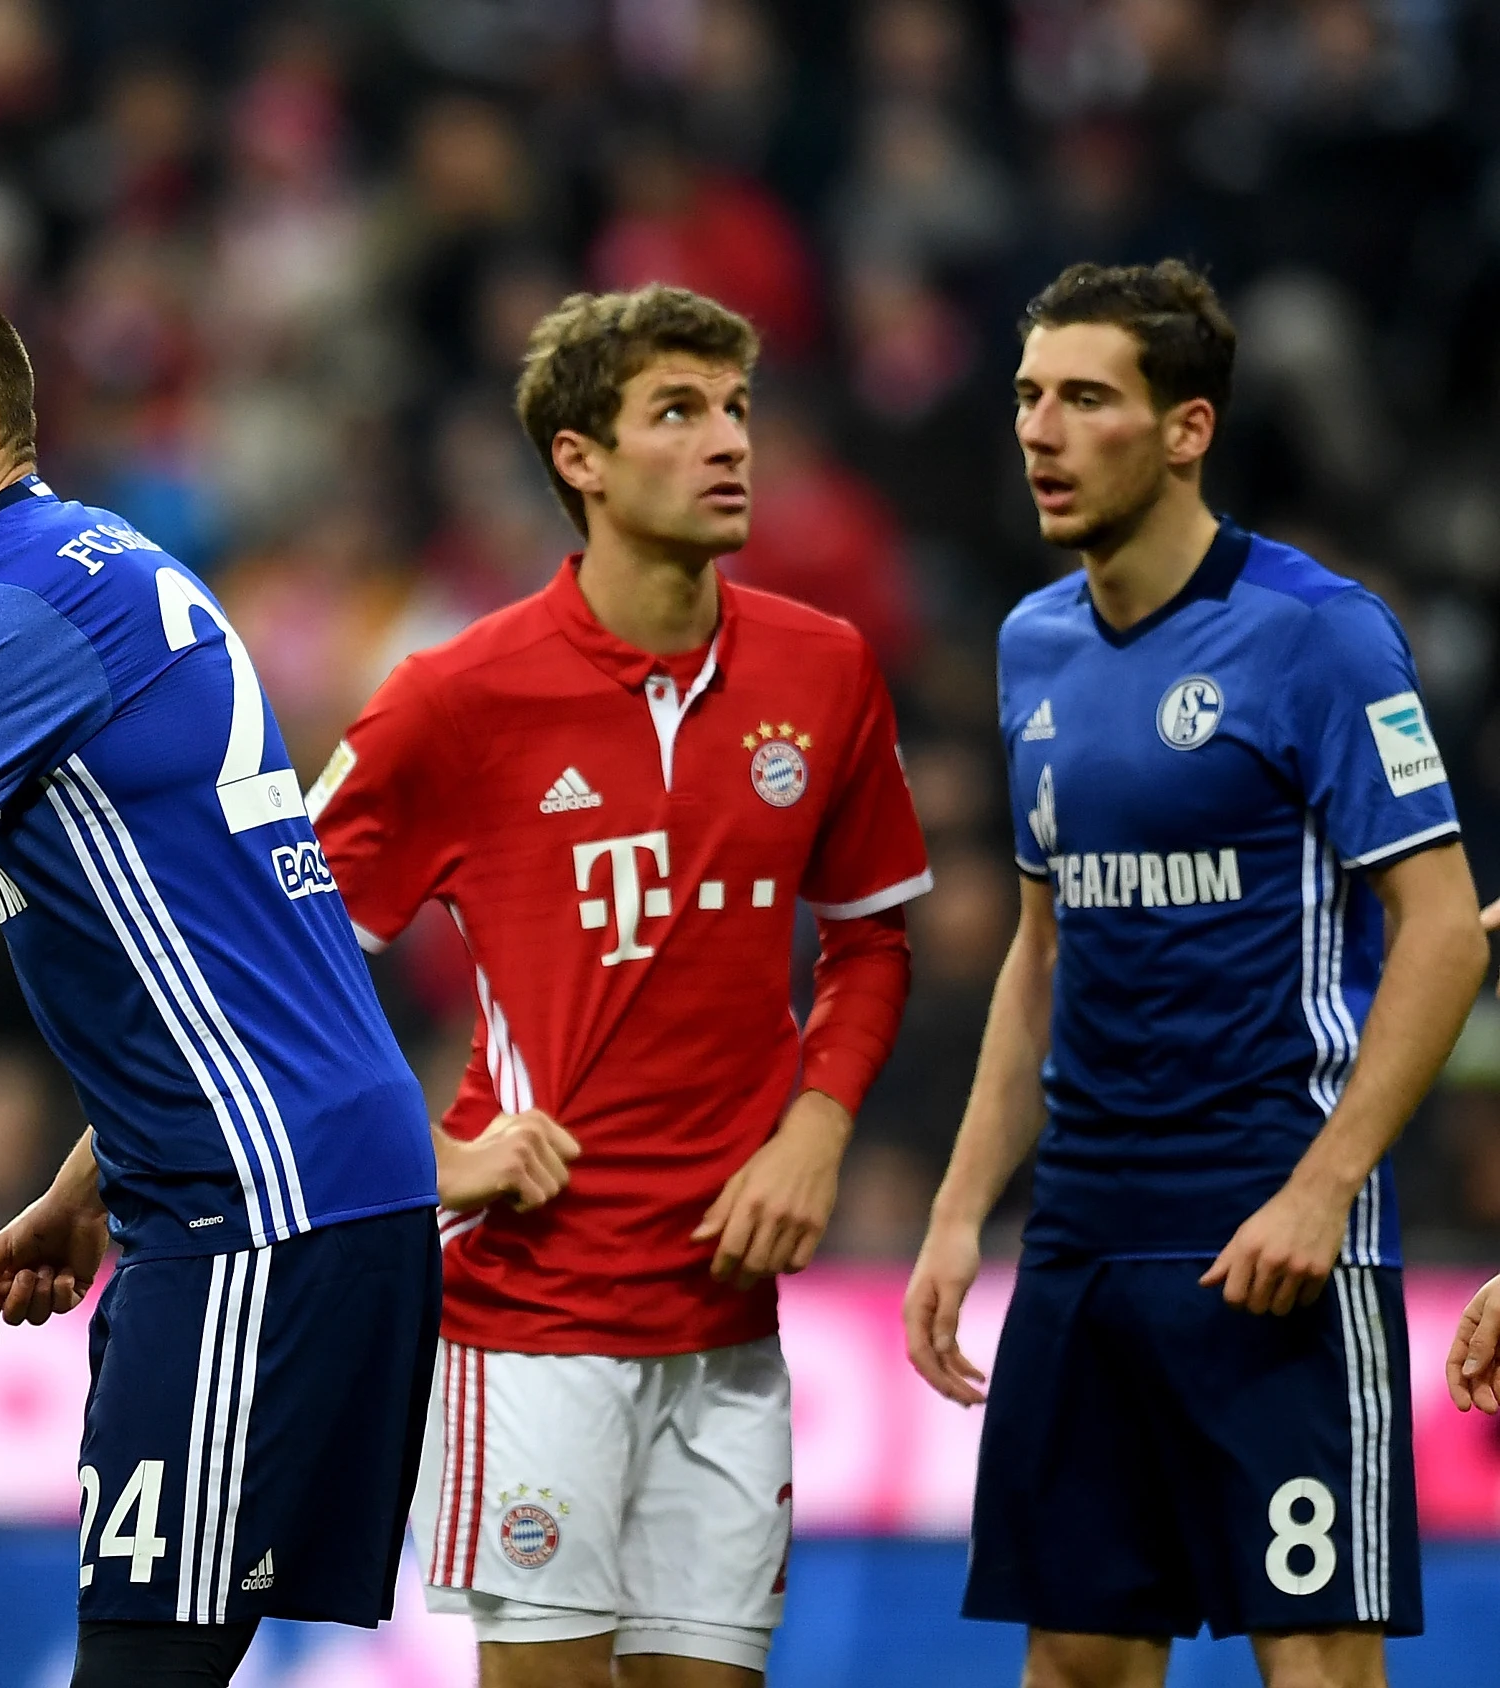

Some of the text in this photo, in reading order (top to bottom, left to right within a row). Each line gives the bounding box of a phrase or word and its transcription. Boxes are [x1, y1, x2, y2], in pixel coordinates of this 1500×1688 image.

[56, 529, 124, 576] FC
[79, 1459, 167, 1589] 24
[1264, 1476, 1337, 1596] 8
